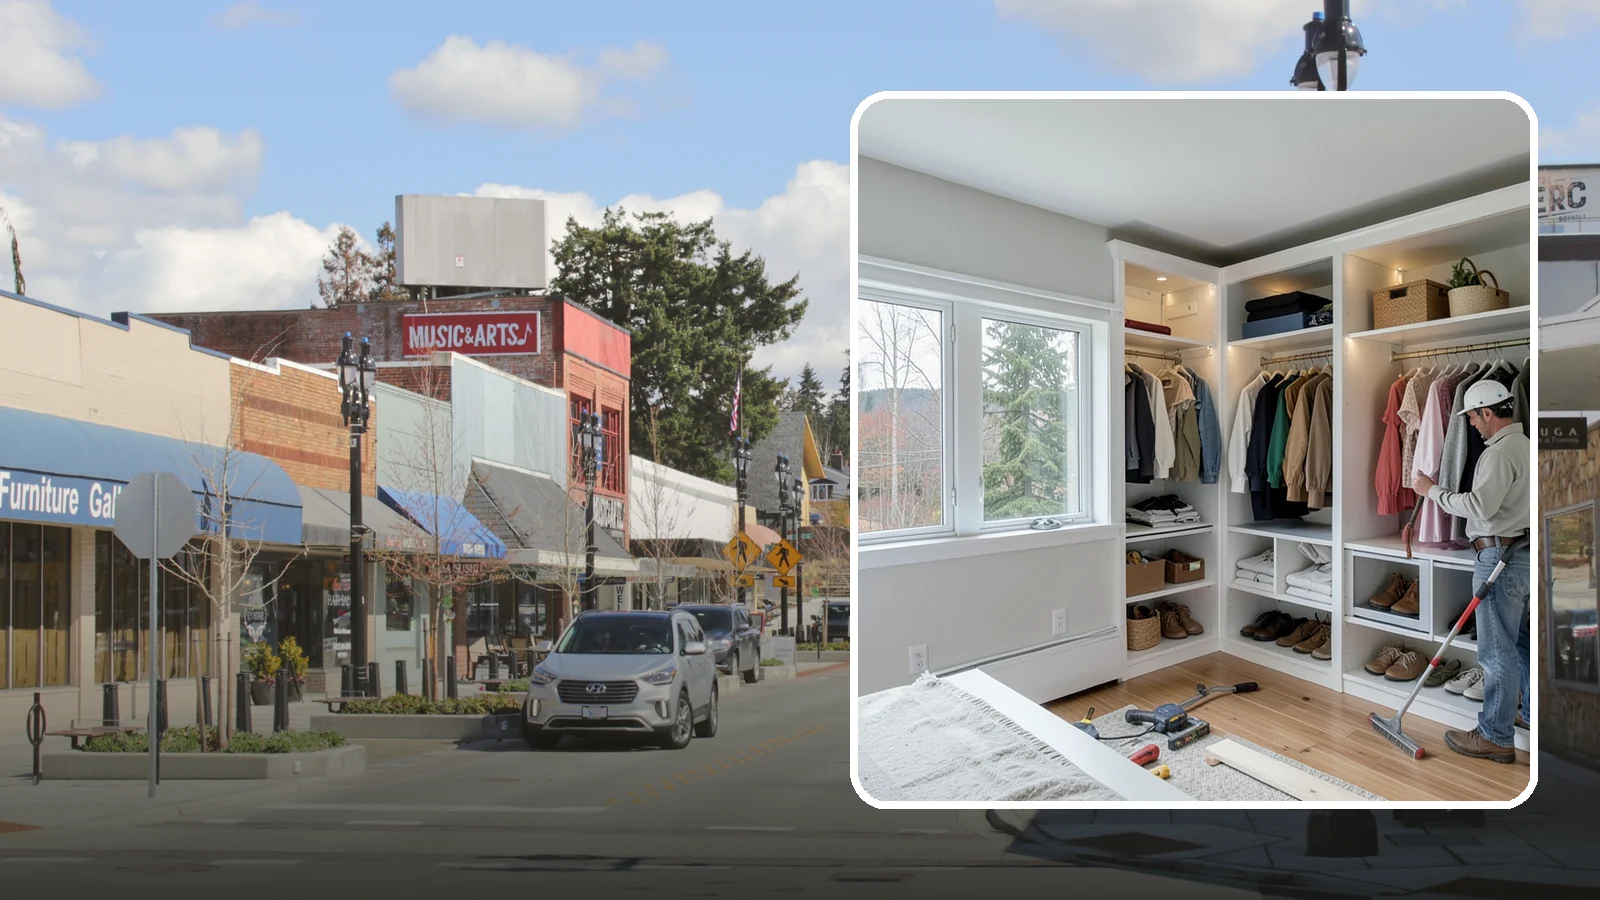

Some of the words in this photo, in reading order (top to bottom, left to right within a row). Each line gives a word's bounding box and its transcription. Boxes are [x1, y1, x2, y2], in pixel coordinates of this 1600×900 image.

[409, 323, 519, 348] MUSIC&ARTS
[1540, 428, 1577, 436] UGA
[0, 471, 79, 515] Furniture
[453, 563, 479, 574] SUSHI
